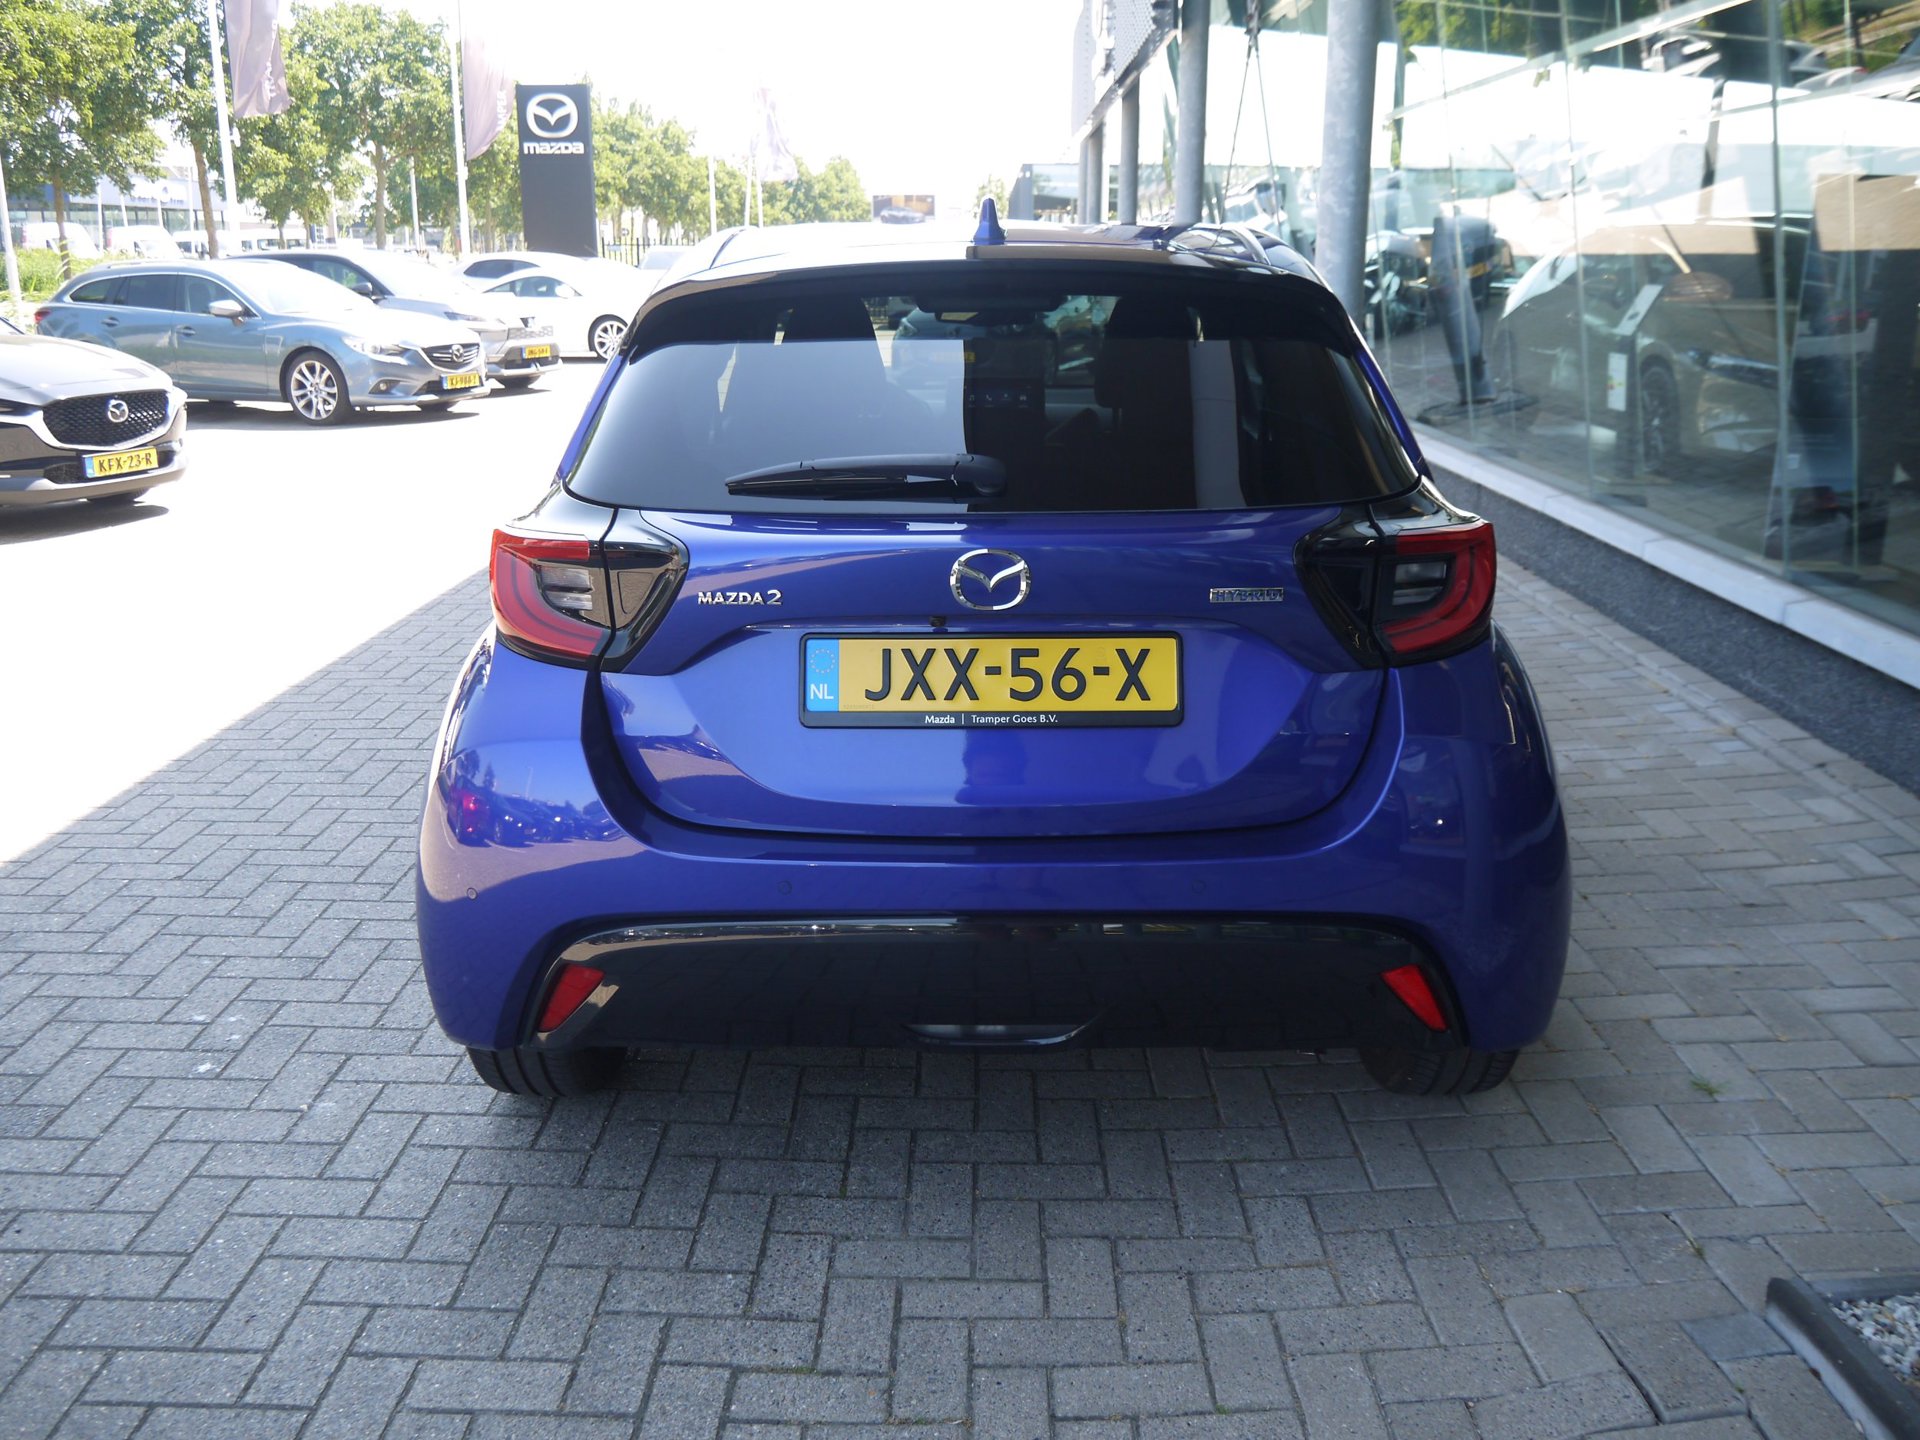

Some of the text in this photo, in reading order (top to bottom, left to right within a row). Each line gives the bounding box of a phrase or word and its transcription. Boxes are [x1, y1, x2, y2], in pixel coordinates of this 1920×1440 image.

[98, 452, 152, 473] KFX-23-R
[697, 589, 782, 605] MAZDA 2
[1210, 587, 1283, 602] HYBRID
[864, 648, 1151, 701] JXX-56-X
[809, 683, 834, 700] NL
[924, 714, 1059, 725] Mazda Tramper Goes B.V.
